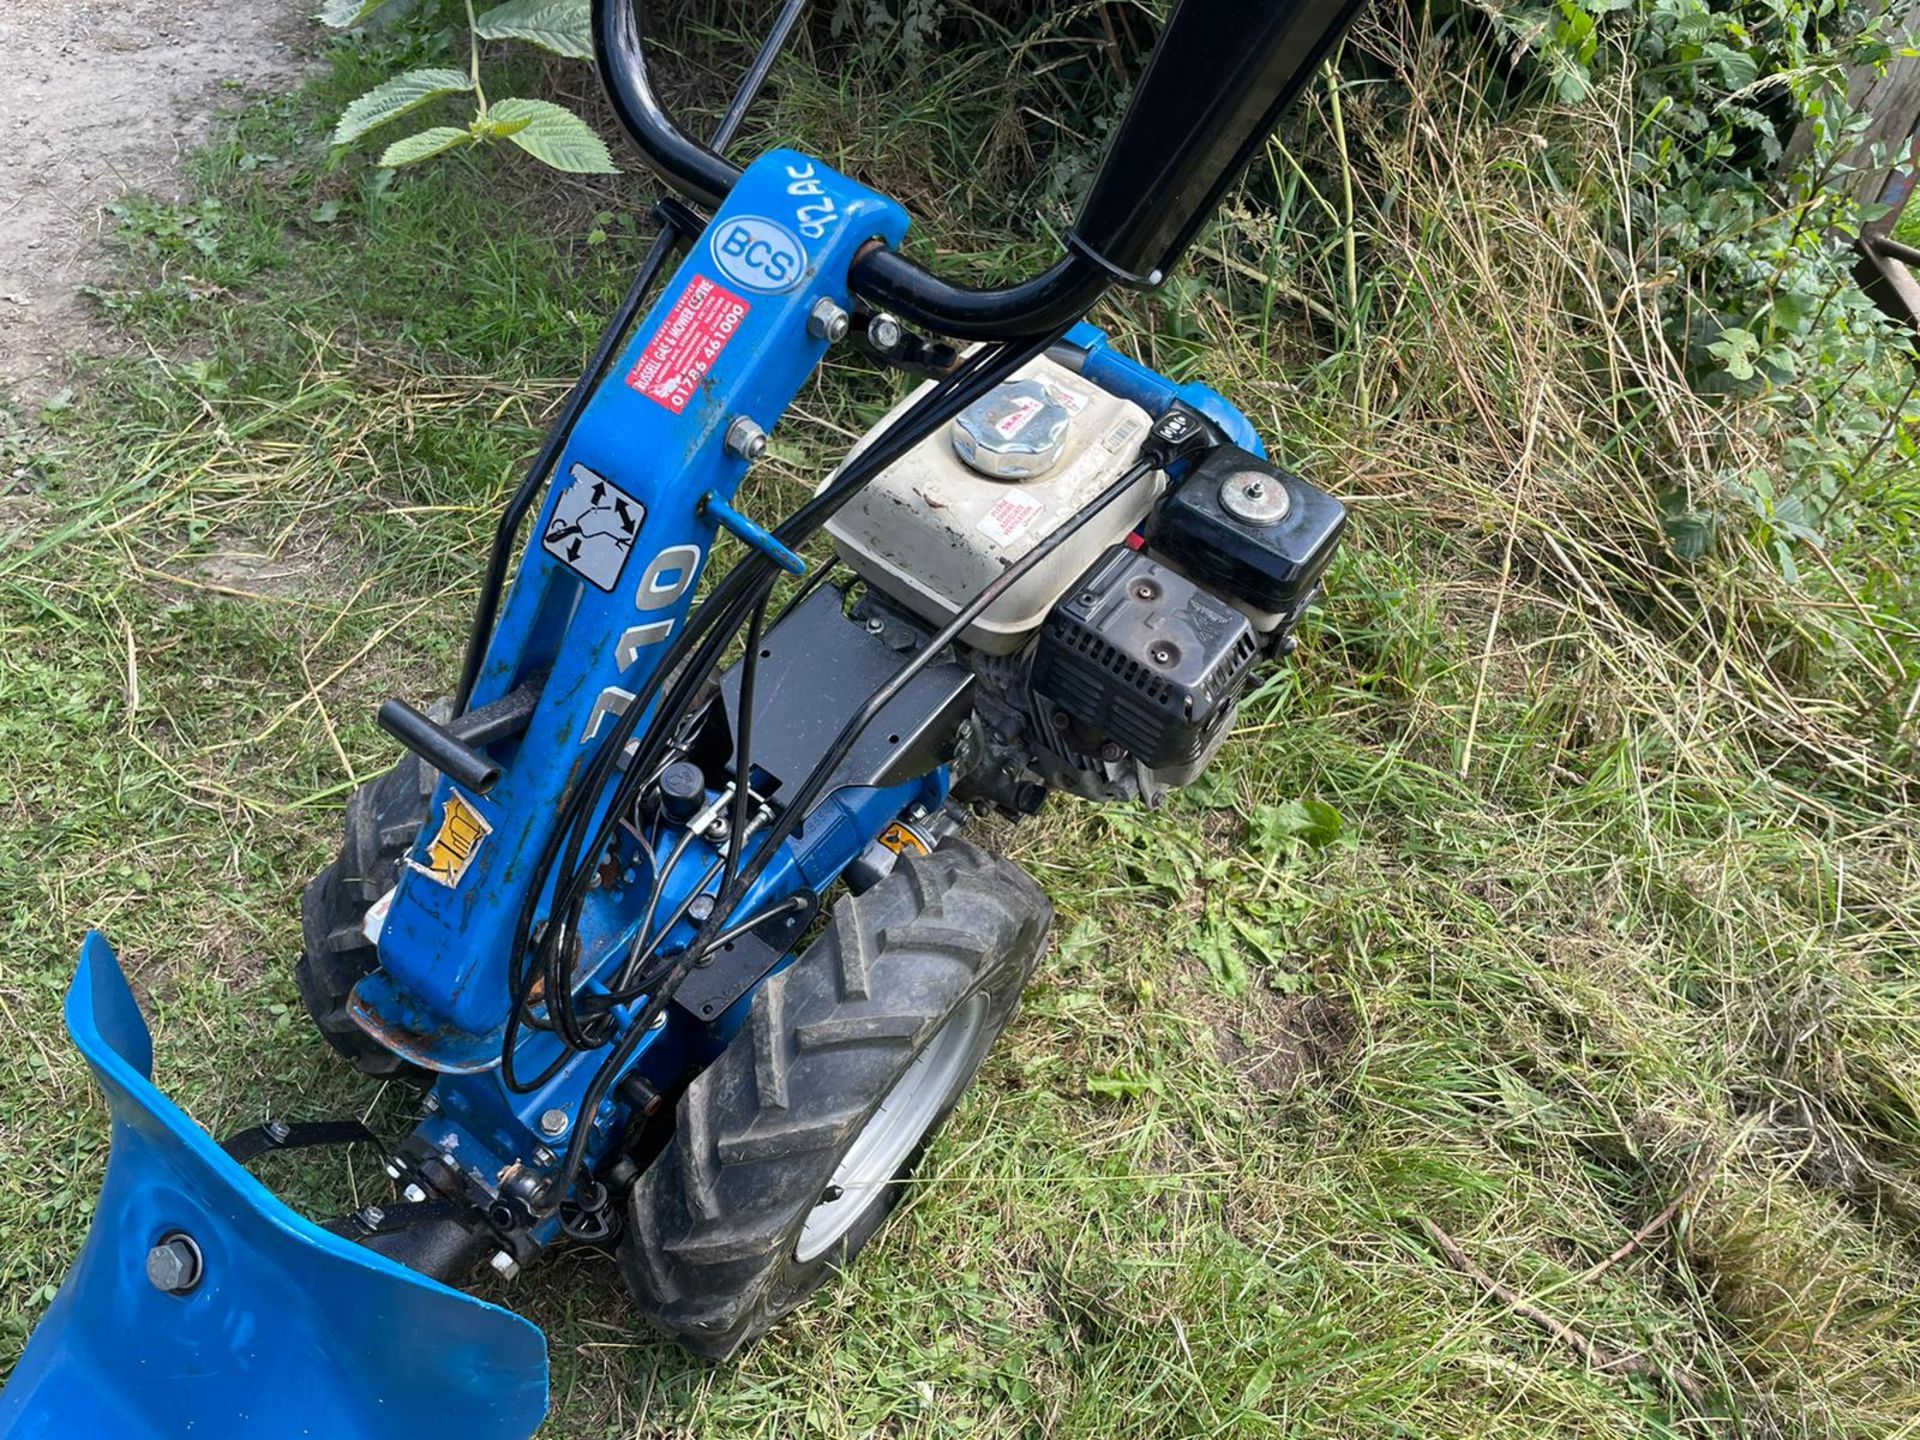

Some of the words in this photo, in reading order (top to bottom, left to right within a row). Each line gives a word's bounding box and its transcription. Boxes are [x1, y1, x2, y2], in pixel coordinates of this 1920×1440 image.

[722, 226, 794, 282] BCS
[687, 278, 714, 311] CENTRE
[668, 306, 695, 339] MOWER
[653, 342, 672, 362] GAS
[664, 334, 676, 346] &
[670, 358, 707, 408] 01786
[702, 302, 745, 360] 461000
[634, 357, 661, 391] RUSSELL
